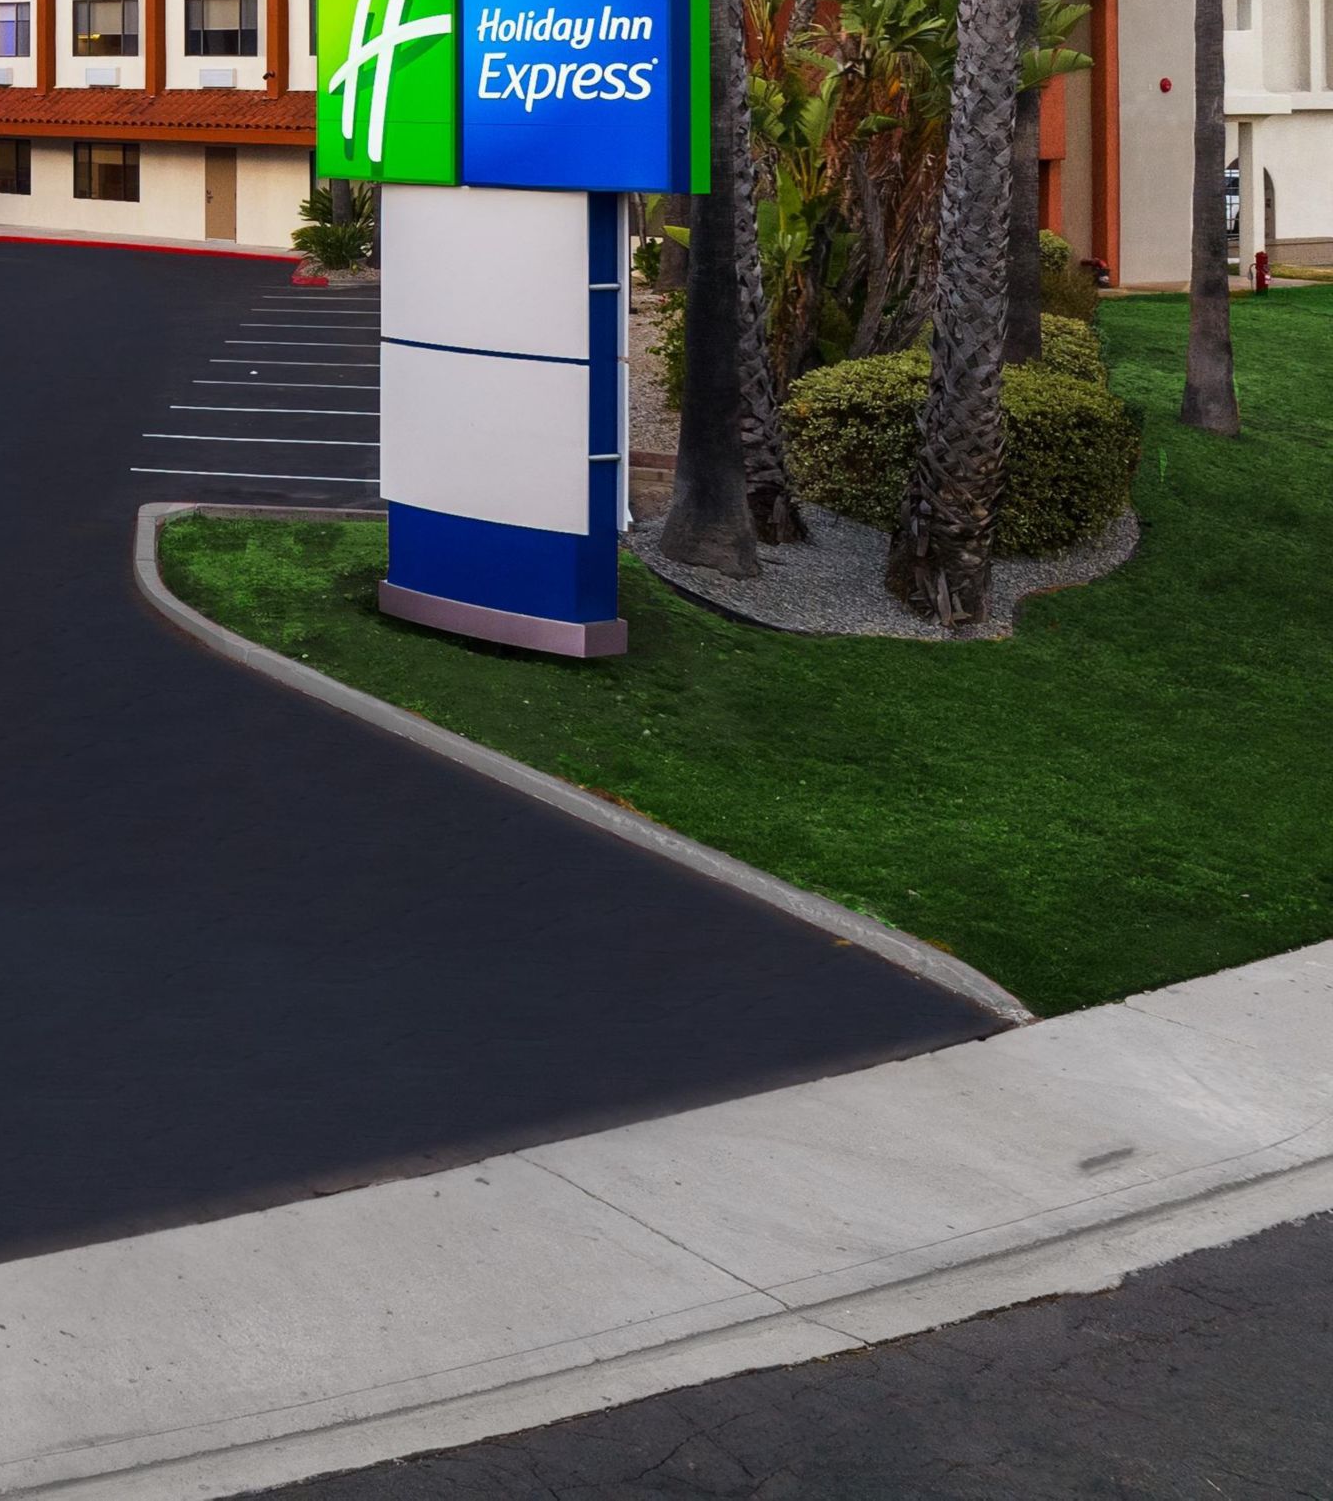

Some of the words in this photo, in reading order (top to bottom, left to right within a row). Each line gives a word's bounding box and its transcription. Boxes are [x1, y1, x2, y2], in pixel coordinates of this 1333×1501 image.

[476, 7, 595, 50] Holiday
[598, 5, 653, 41] Inn
[477, 52, 654, 113] Express
